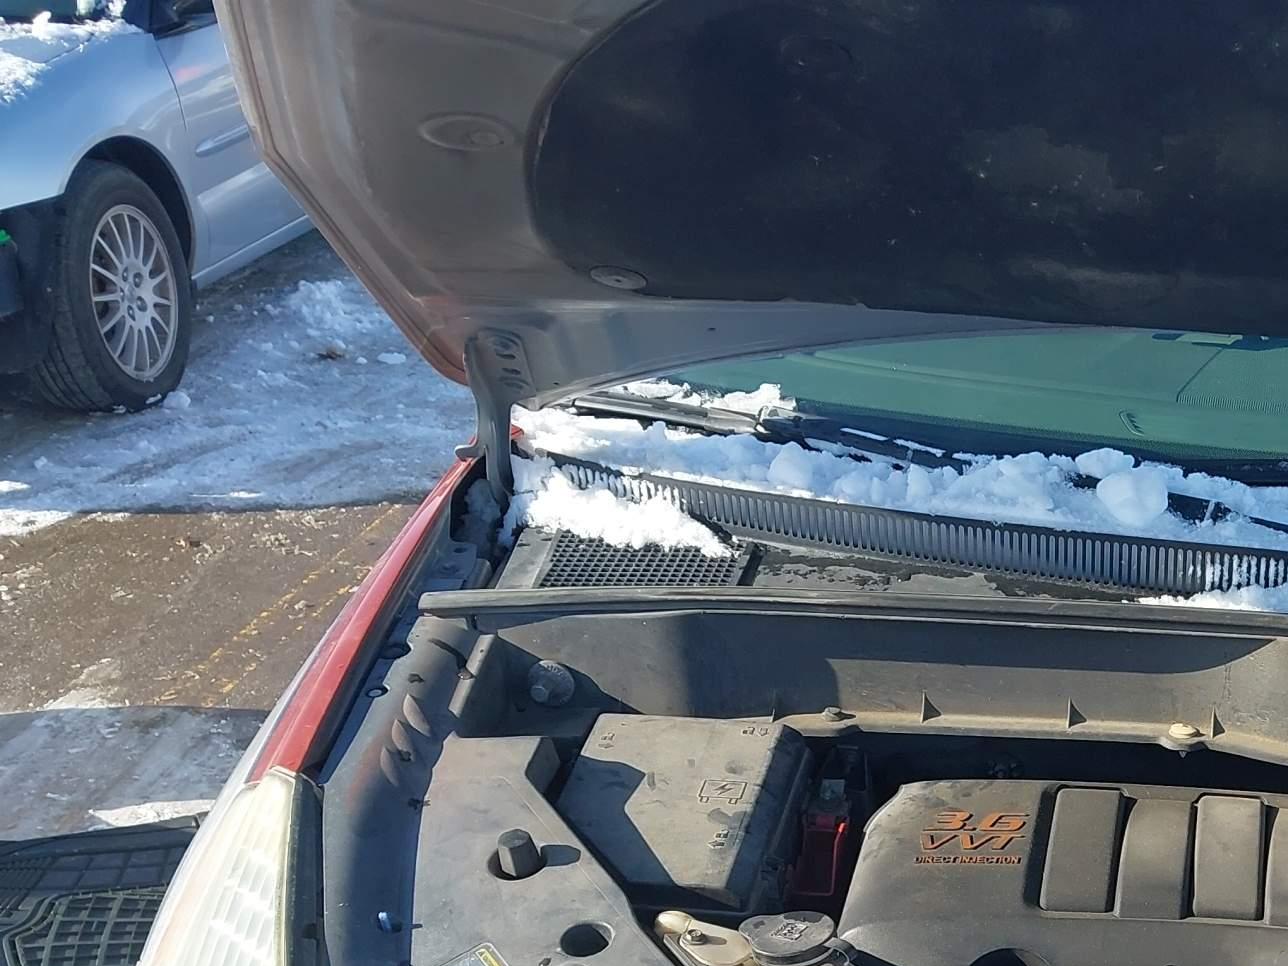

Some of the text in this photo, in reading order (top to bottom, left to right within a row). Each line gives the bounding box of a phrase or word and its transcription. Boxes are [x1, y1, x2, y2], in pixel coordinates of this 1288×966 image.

[922, 809, 1030, 832] 3.6
[921, 831, 1027, 851] VVT
[914, 855, 1022, 865] DIRECT INJECTION
